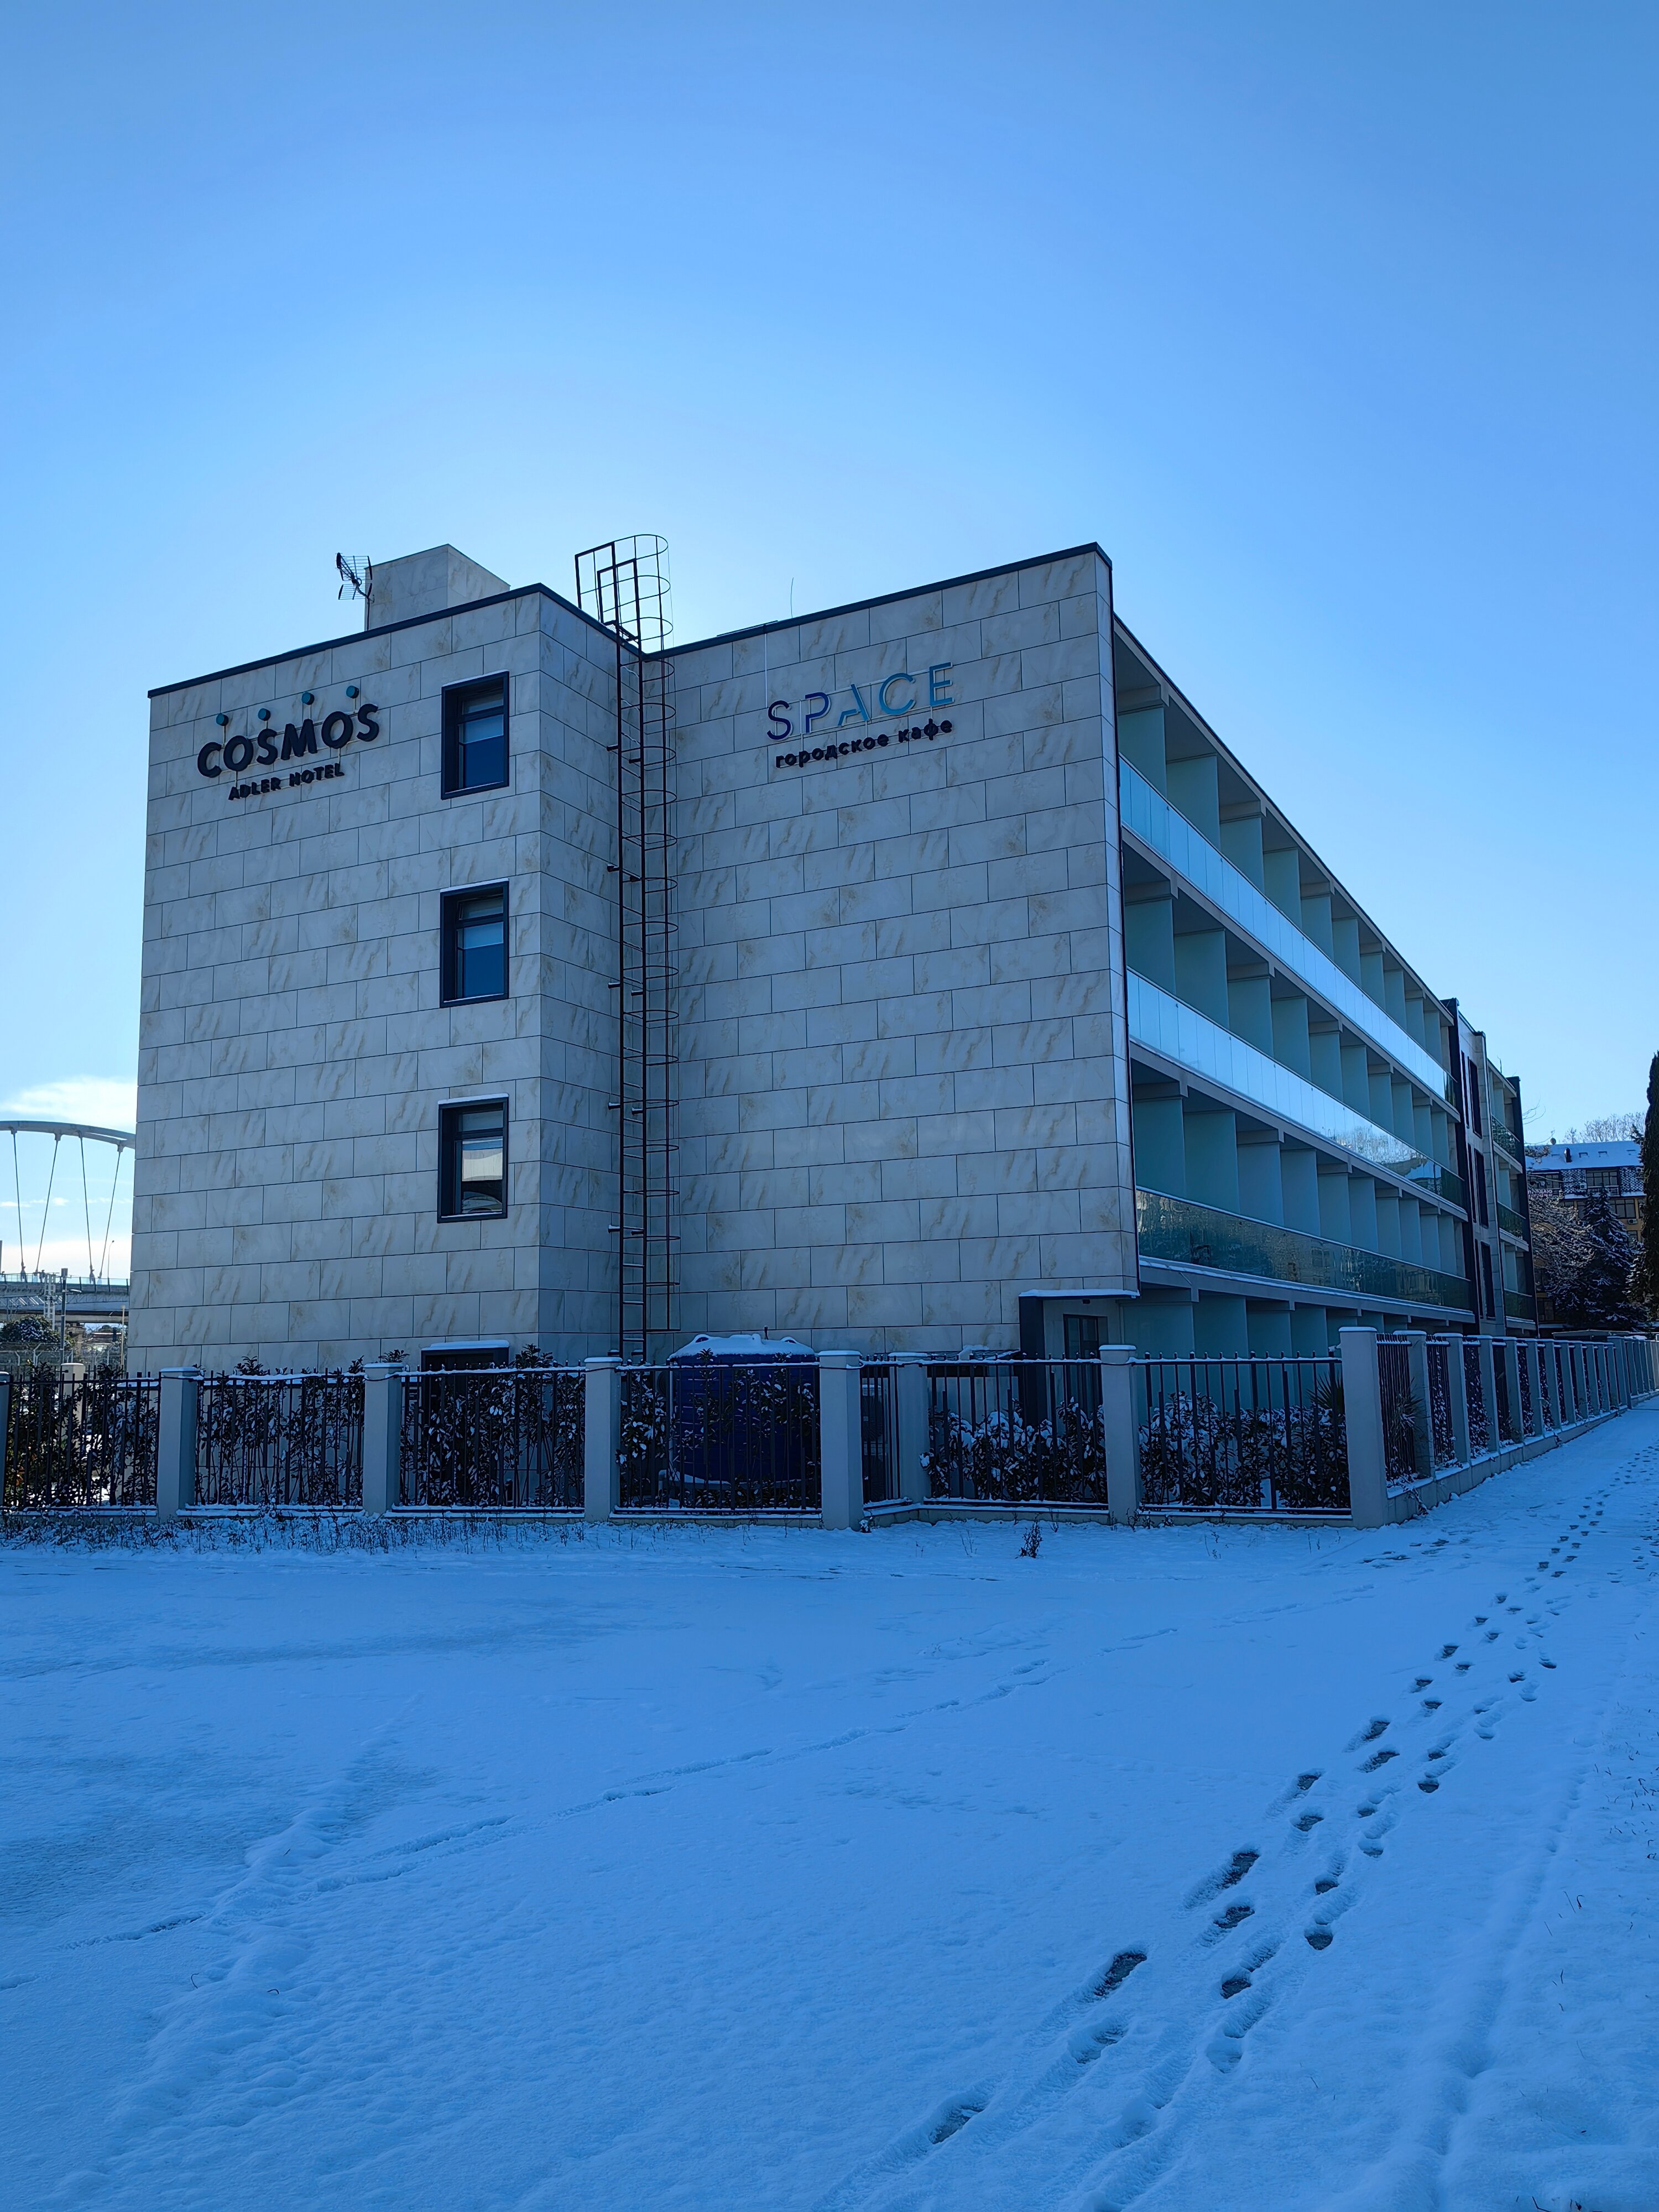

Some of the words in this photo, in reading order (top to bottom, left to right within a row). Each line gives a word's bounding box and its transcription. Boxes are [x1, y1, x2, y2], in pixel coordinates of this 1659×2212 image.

[767, 662, 954, 741] SPACE
[197, 703, 379, 778] COSMOS
[776, 734, 889, 768] городское
[898, 718, 953, 743] кафе
[228, 777, 281, 800] ADLER
[289, 763, 345, 787] HOTEL
